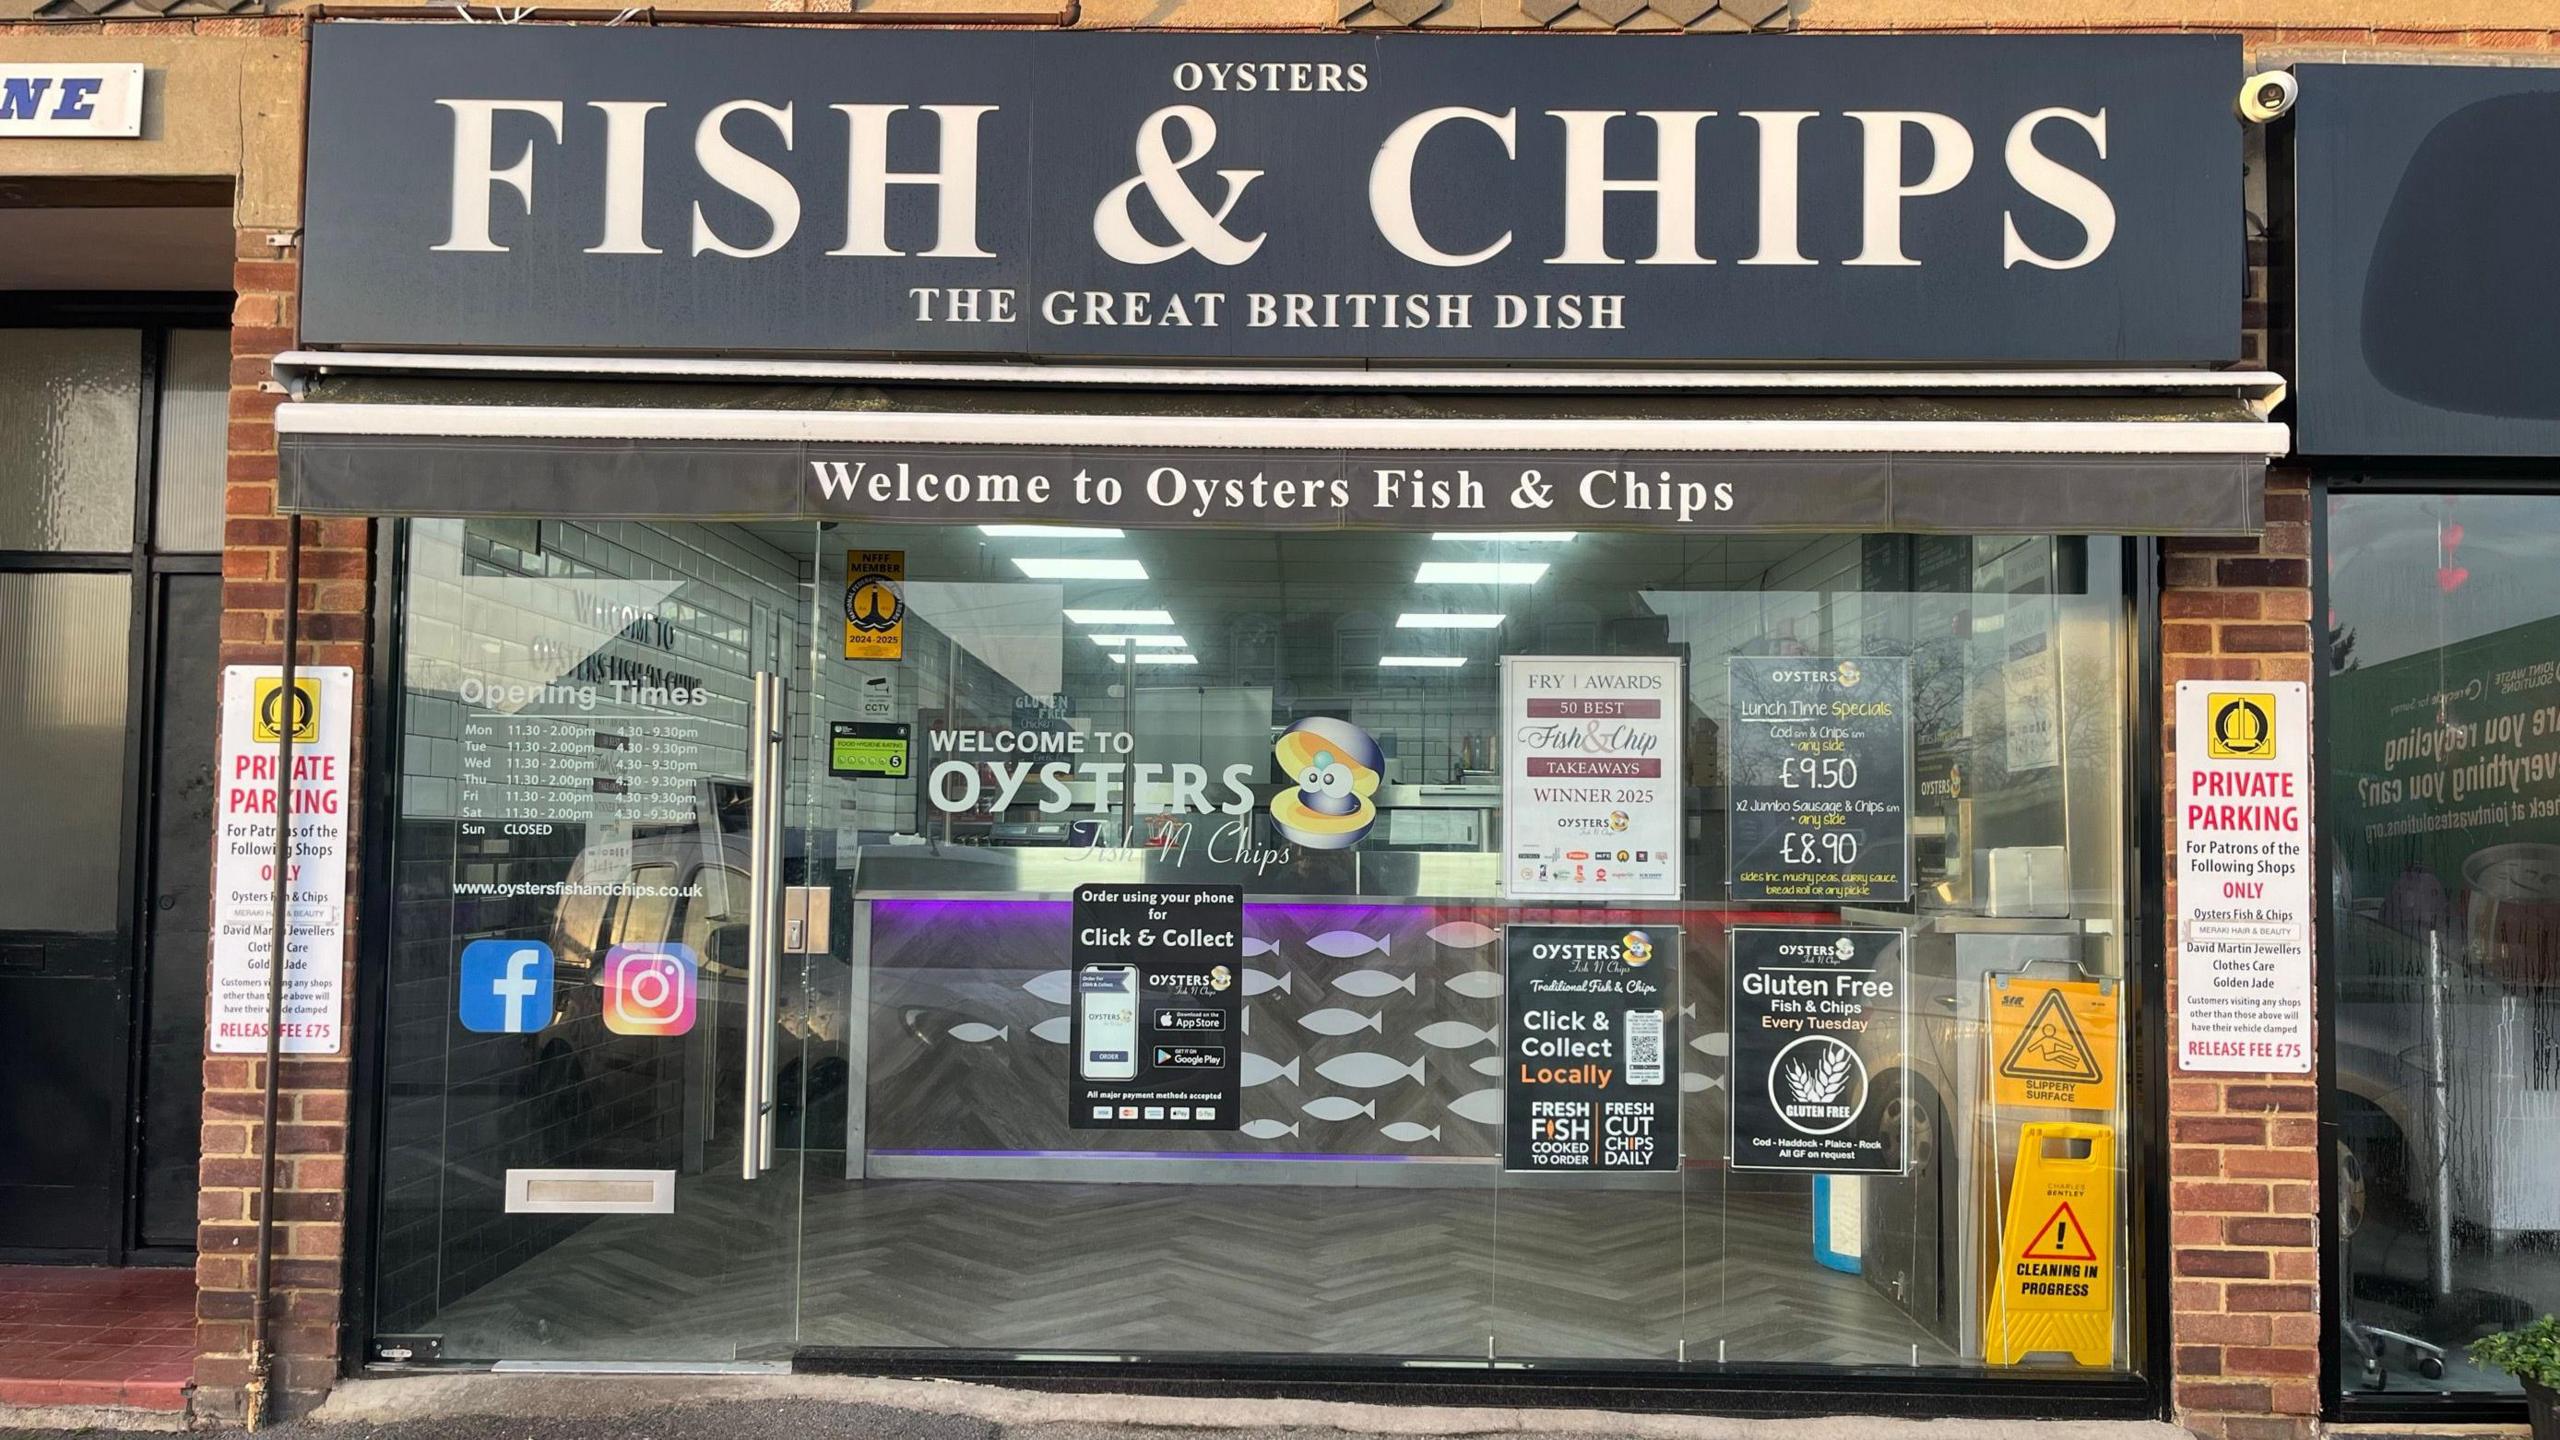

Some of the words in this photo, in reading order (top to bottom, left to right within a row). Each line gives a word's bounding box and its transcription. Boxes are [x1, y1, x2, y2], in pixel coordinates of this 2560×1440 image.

[1173, 61, 1368, 93] OYSTERS
[430, 98, 999, 259] FISH
[1093, 104, 1267, 265] &
[1369, 106, 2116, 271] CHIPS
[909, 287, 1016, 324] THE
[1042, 290, 1225, 327] GREAT
[1248, 293, 1473, 330] BRITISH
[1494, 294, 1626, 331] DISH
[811, 460, 1050, 503] Welcome
[1074, 469, 1122, 506] to
[1147, 466, 1349, 517] Oysters
[1374, 468, 1485, 510] Fish
[1511, 471, 1553, 510] &
[1580, 469, 1733, 520] Chips
[863, 553, 891, 562] NFFF
[851, 564, 900, 572] MEMBER
[850, 635, 871, 643] 2024
[1529, 675, 1565, 688] FRY
[1585, 675, 1662, 689] AWARDS
[1772, 671, 1837, 682] OYSTERS
[459, 678, 597, 711] Opening
[609, 680, 708, 706] Times
[865, 704, 890, 712] CCTV
[1560, 702, 1577, 714] 50
[1584, 702, 1625, 714] BEST
[1741, 701, 1787, 716] Lunch
[1791, 701, 1828, 716] Time
[1831, 701, 1893, 720] Specials
[465, 725, 492, 735] Mon
[508, 725, 540, 736] 11.30
[551, 726, 595, 740] 2.00pm
[617, 726, 641, 738] 4.30
[652, 727, 698, 741] 9.30pm
[1518, 724, 1584, 749] Fish
[1582, 719, 1615, 753] &
[1610, 724, 1658, 756] Chip
[1770, 726, 1793, 738] Cod
[1819, 727, 1849, 742] Chips
[464, 742, 486, 752] Tue
[929, 730, 1084, 754] WELCOME
[1095, 731, 1134, 755] TO
[236, 755, 335, 780] PRIATE
[1546, 762, 1640, 774] TAKEAWAYS
[1779, 758, 1857, 789] £9.50
[928, 760, 1255, 815] OYSTERS
[2192, 772, 2294, 797] PRIVATE
[1534, 788, 1613, 802] WINNER
[1617, 789, 1654, 803] 2025
[1750, 799, 1790, 812] Jumbo
[1793, 800, 1843, 817] Sausage
[1855, 801, 1884, 816] Chips
[1558, 818, 1609, 828] OYSTERS
[2188, 805, 2298, 831] PARKING
[462, 824, 485, 835] Sun
[504, 824, 552, 835] CLOSED
[1064, 819, 1134, 863] Fish
[1160, 819, 1192, 868] N
[1207, 820, 1290, 875] Chips
[1780, 832, 1857, 864] £8.90
[2186, 841, 2206, 853] For
[2210, 841, 2258, 854] Patrons
[2262, 842, 2276, 854] of
[2279, 842, 2299, 855] the
[2192, 859, 2254, 876] Following
[2257, 860, 2295, 876] Shops
[453, 882, 702, 898] www.oystersfishandchips.co.uk
[2223, 882, 2263, 899] ONLY
[1082, 890, 1119, 902] Order
[1123, 891, 1157, 905] using
[1161, 892, 1190, 905] your
[1194, 892, 1234, 906] phone
[1148, 908, 1167, 920] for
[2194, 908, 2231, 921] Oysters
[2234, 908, 2253, 920] Fish
[2265, 909, 2293, 922] Chips
[1081, 928, 1131, 946] Click
[1138, 929, 1156, 946] &
[1163, 929, 1234, 947] Collect
[1532, 944, 1621, 960] OYSTERS
[1779, 945, 1834, 956] OYSTERS
[2187, 942, 2215, 953] David
[2217, 942, 2251, 954] Martin
[2253, 943, 2301, 955] Jewellers
[2213, 960, 2250, 971] Clothes
[2252, 960, 2275, 971] Care
[1150, 974, 1210, 986] OYSTERS
[1530, 979, 1588, 993] Traditional
[1589, 979, 1613, 993] Fish
[1626, 980, 1657, 995] Chips
[1742, 973, 1828, 997] Gluten
[1836, 976, 1894, 998] Free
[2213, 977, 2249, 988] Golden
[2252, 977, 2275, 988] Jade
[1771, 999, 1801, 1012] Fish
[1805, 1000, 1816, 1013] &
[1820, 1000, 1862, 1016] Chips
[1176, 1018, 1196, 1028] App
[1196, 1018, 1219, 1028] Store
[1523, 1010, 1586, 1031] Click
[1592, 1010, 1610, 1031] &
[1762, 1015, 1804, 1031] Every
[1807, 1016, 1869, 1033] Tuesday
[1521, 1037, 1613, 1058] Collect
[2189, 1042, 2245, 1056] RELEASE
[2250, 1042, 2272, 1057] FEE
[2276, 1043, 2301, 1057] £75
[1174, 1054, 1202, 1065] Google
[1203, 1054, 1221, 1066] Play
[1521, 1064, 1613, 1089] Locally
[2026, 1079, 2076, 1092] SLIPPERY
[1087, 1090, 1098, 1099] All
[1100, 1090, 1121, 1100] major
[1123, 1091, 1154, 1100] payment
[1155, 1091, 1187, 1099] methods
[1189, 1091, 1222, 1100] accepted
[2026, 1090, 2075, 1102] SURFACE
[1532, 1101, 1590, 1117] FRESH
[1605, 1102, 1655, 1115] FRESH
[1786, 1104, 1824, 1118] GLUTEN
[1826, 1105, 1850, 1119] FREE
[1605, 1116, 1655, 1136] CUT
[1532, 1142, 1589, 1154] COOKED
[1605, 1136, 1654, 1151] CHIPS
[1752, 1138, 1771, 1147] Cod
[1778, 1138, 1817, 1148] Haddock
[1824, 1139, 1852, 1149] Plaice
[1859, 1140, 1882, 1149] Rock
[1532, 1154, 1547, 1164] TO
[1550, 1154, 1589, 1165] ORDER
[1605, 1151, 1654, 1165] DAILY
[2047, 1189, 2084, 1197] BENTLEY
[2016, 1263, 2080, 1278] CLEANING
[2084, 1265, 2098, 1278] IN
[2021, 1282, 2089, 1297] PROGRESS
